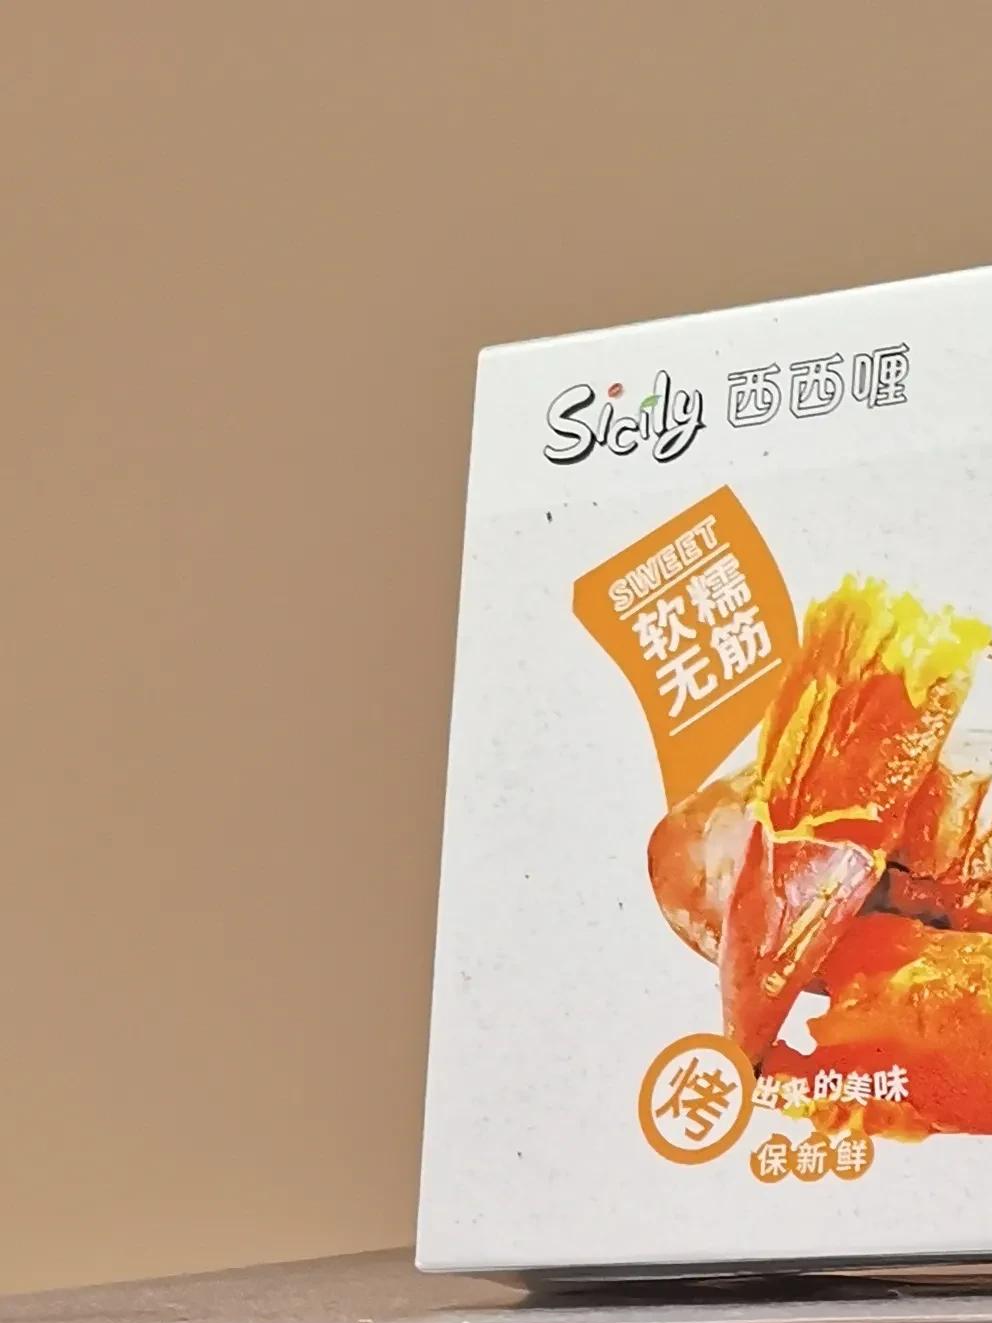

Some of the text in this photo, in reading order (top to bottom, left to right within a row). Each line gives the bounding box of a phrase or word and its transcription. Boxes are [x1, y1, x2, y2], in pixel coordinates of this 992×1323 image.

[543, 370, 705, 464] Sicily
[727, 342, 910, 428] 西西喱
[608, 515, 717, 612] SWEET
[632, 553, 752, 661] 软糯
[656, 606, 772, 718] 无筋
[655, 1057, 909, 1141] 烤 出来的美味
[757, 1136, 867, 1175] 保新鲜
